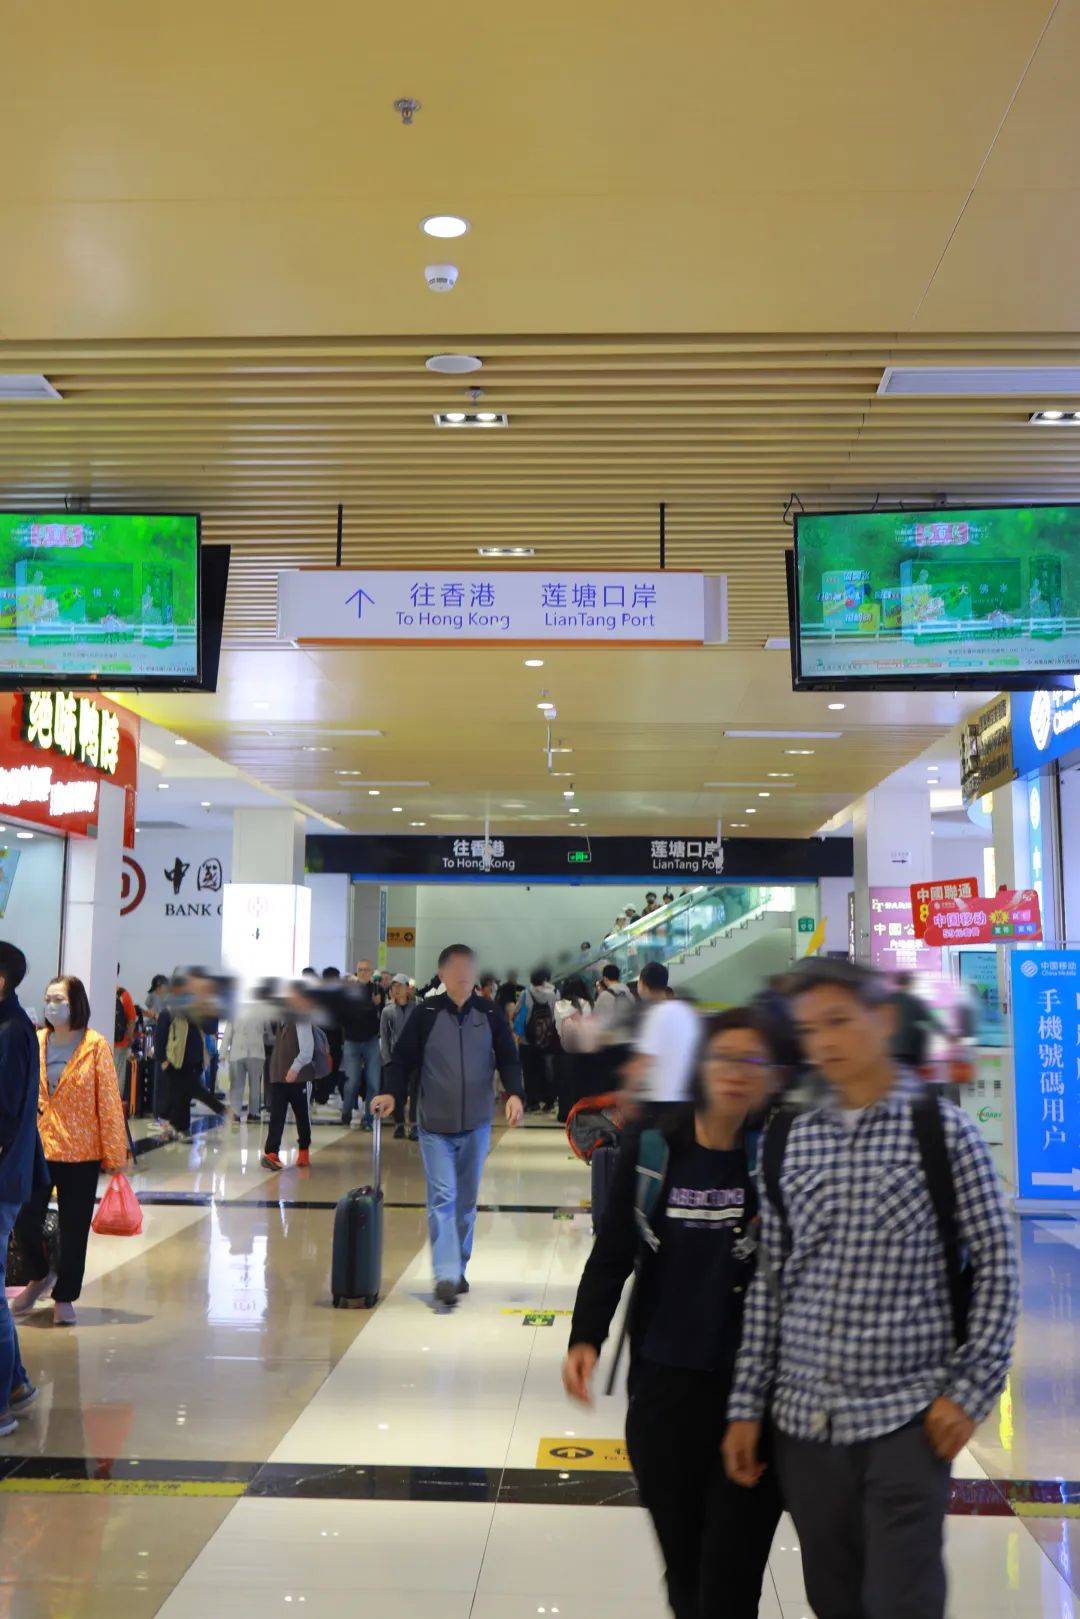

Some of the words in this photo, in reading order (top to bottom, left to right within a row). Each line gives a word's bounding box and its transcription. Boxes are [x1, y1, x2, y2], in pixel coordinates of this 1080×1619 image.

[409, 582, 495, 607] 往香港
[541, 583, 657, 608] 莲塘口岸
[395, 611, 414, 625] To
[419, 612, 463, 629] Hong
[468, 612, 510, 630] Kong
[545, 612, 616, 630] LianTang
[621, 613, 655, 626] Port
[452, 839, 505, 858] 往香港
[442, 858, 454, 869] To
[457, 858, 485, 871] Hong
[652, 859, 699, 872] LianTang
[165, 903, 212, 917] BANK
